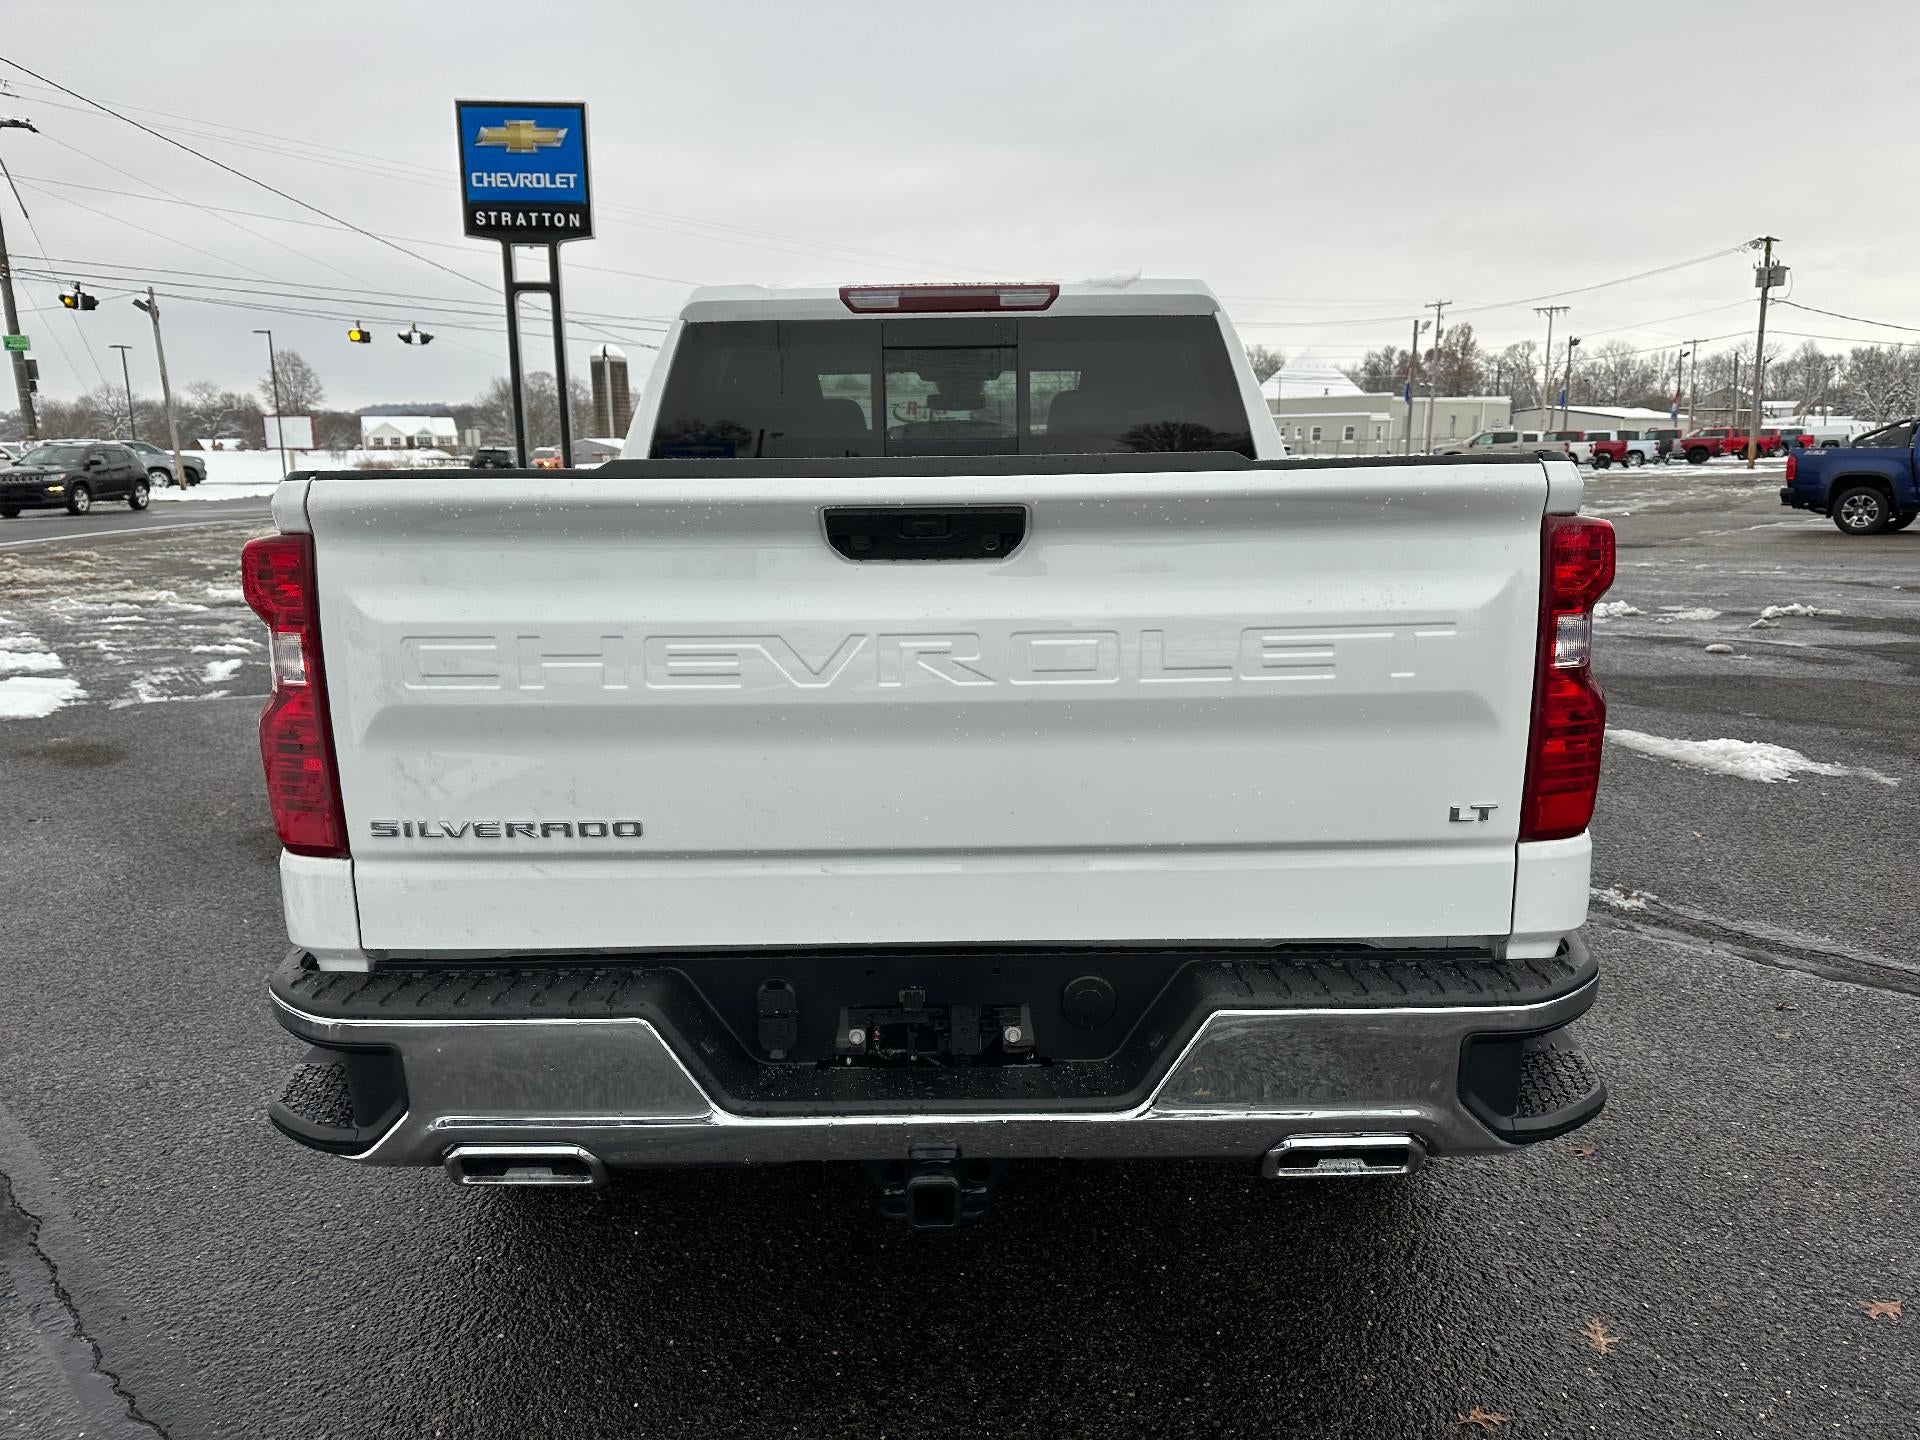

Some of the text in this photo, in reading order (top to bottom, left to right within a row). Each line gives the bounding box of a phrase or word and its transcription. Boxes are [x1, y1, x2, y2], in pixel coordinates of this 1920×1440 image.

[471, 172, 577, 188] CHEVROLET
[475, 211, 580, 227] STRATTON
[400, 622, 1458, 690] CHEVROLET
[1449, 803, 1499, 822] LT
[370, 819, 643, 839] SILVERADO
